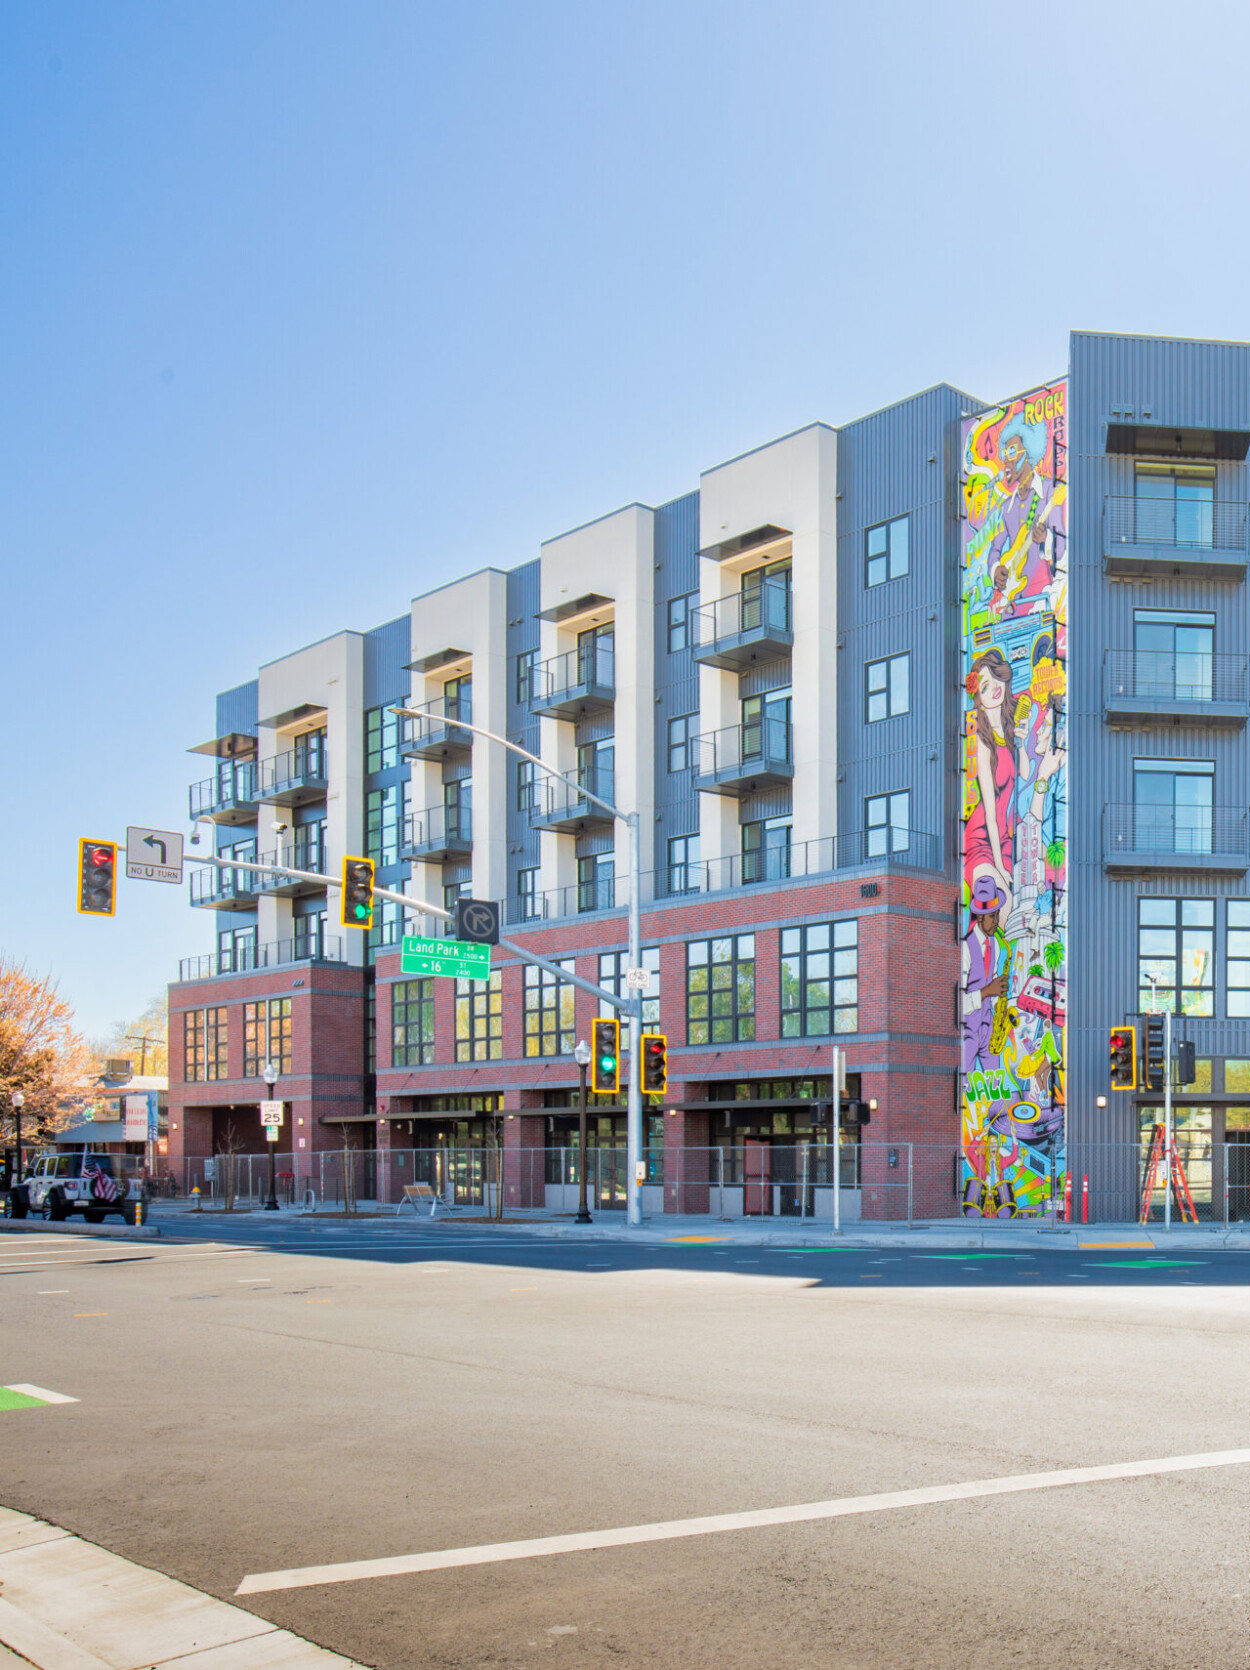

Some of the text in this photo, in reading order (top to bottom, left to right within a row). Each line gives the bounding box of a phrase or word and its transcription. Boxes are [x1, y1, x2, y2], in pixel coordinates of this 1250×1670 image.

[1025, 390, 1064, 426] ROCK
[1035, 662, 1059, 682] TOWER
[1033, 676, 1063, 697] RECORDS
[966, 709, 978, 804] SOUL
[131, 866, 178, 879] NO U TURN
[409, 940, 434, 953] Land
[437, 943, 459, 956] Park
[463, 952, 478, 960] 2500
[965, 1069, 1012, 1103] JAZZ
[264, 1113, 280, 1123] 25
